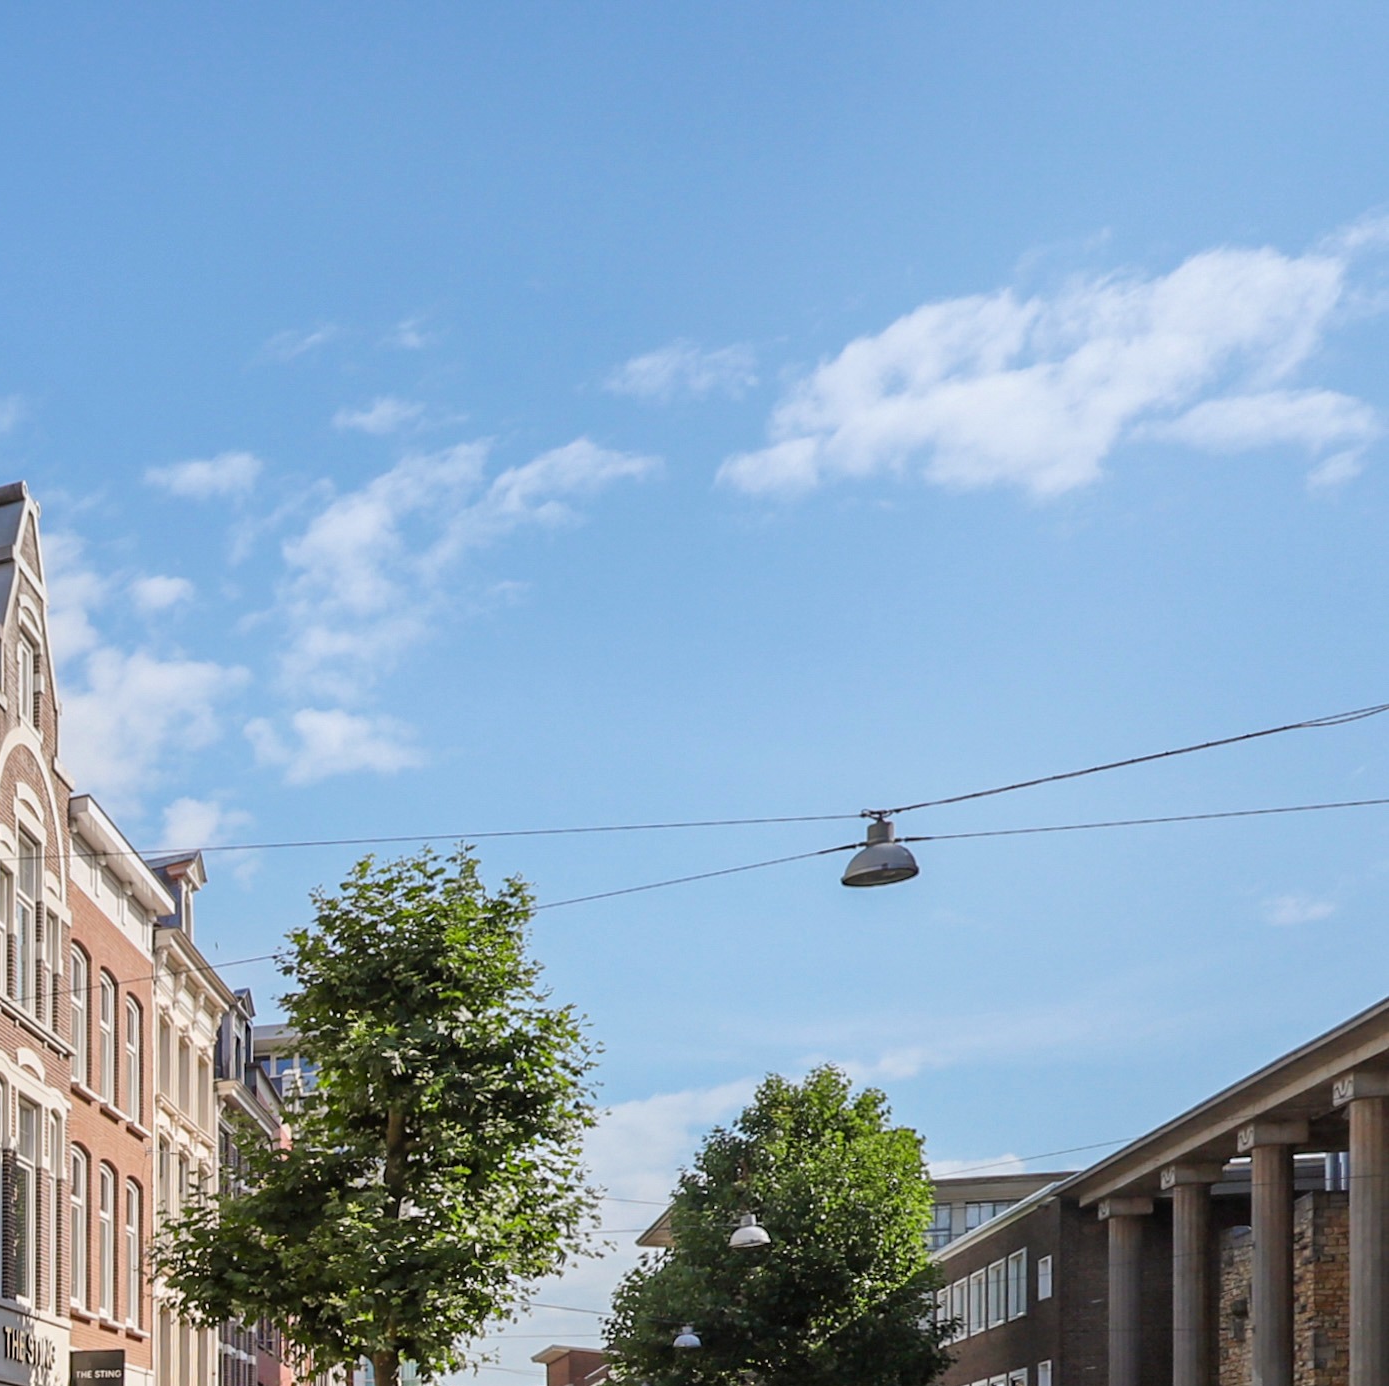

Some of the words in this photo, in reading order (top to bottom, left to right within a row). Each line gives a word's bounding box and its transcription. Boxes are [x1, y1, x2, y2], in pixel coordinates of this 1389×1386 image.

[3, 1326, 25, 1363] THE
[25, 1332, 56, 1370] STING
[76, 1370, 93, 1379] THE
[94, 1369, 122, 1379] STING
